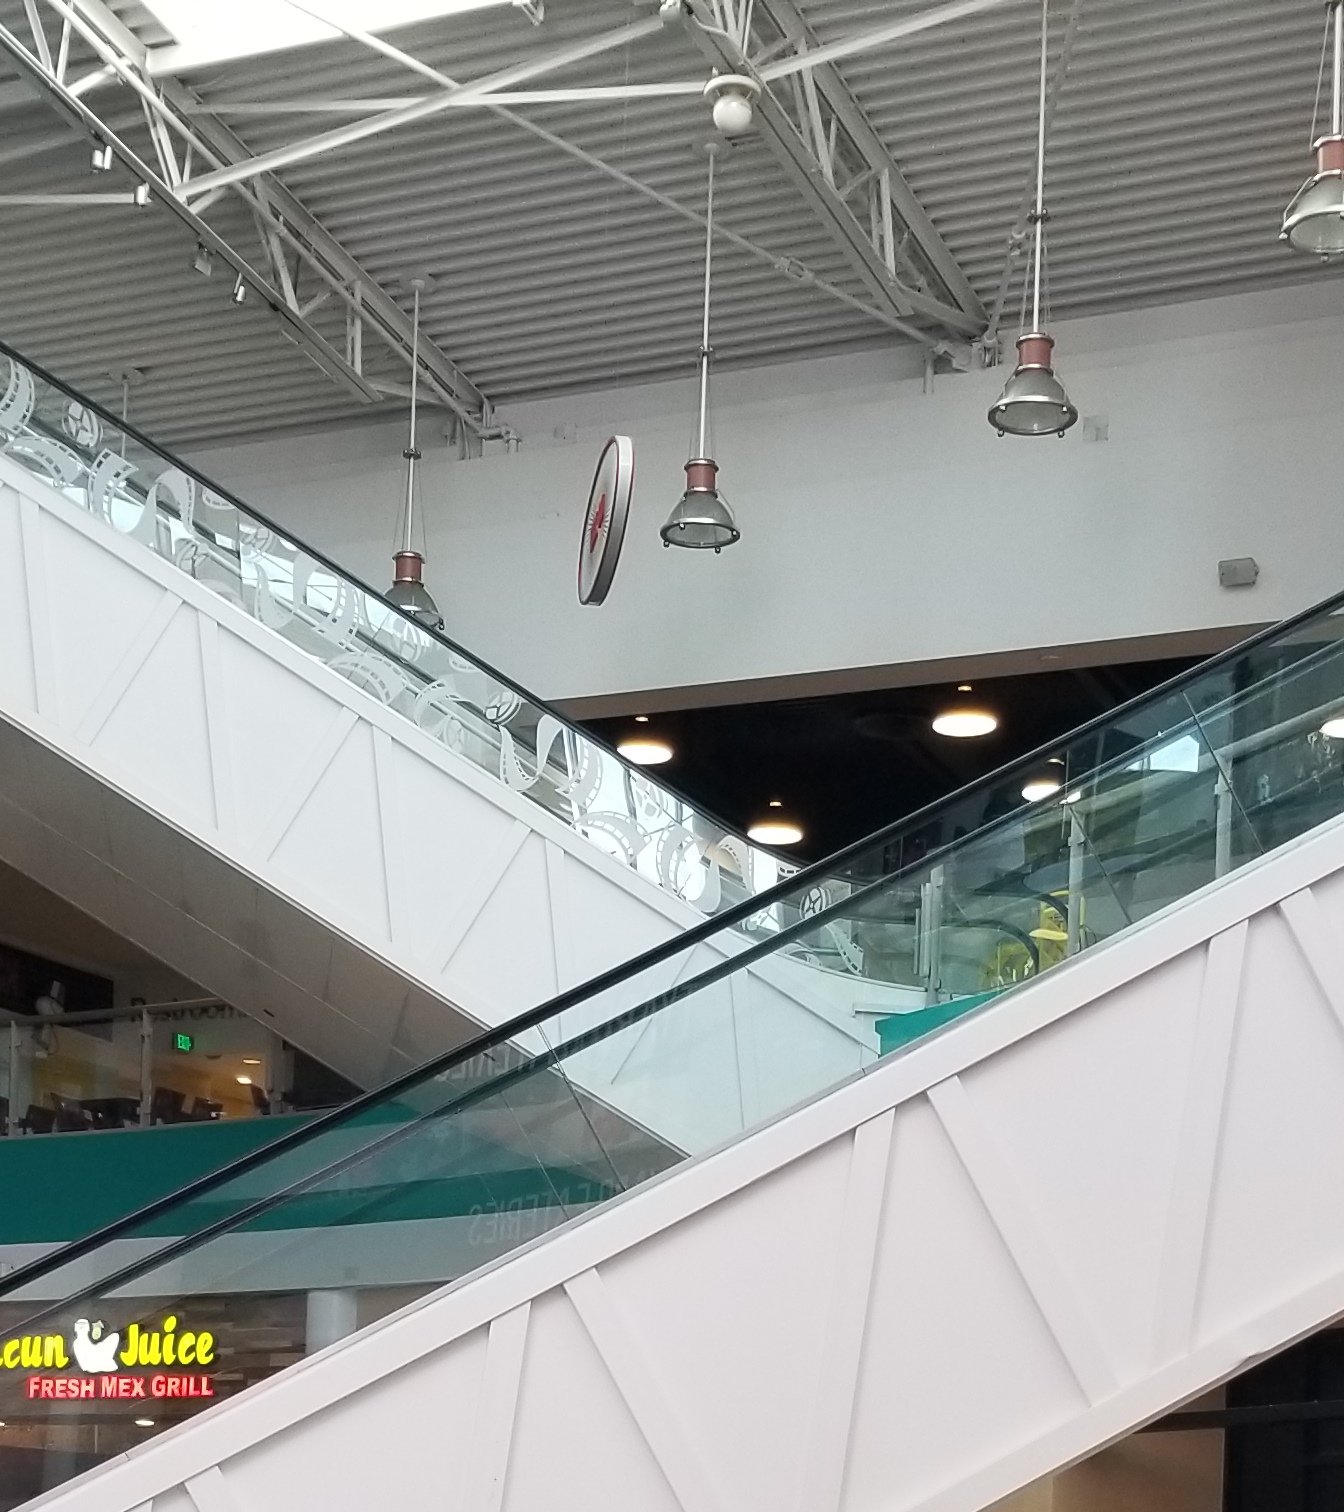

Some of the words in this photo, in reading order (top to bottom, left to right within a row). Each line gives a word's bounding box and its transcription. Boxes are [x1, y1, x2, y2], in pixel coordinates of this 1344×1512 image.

[119, 1315, 215, 1367] Juice
[29, 1376, 95, 1399] FRESH
[101, 1375, 146, 1399] MEX
[151, 1375, 213, 1398] GRILL
